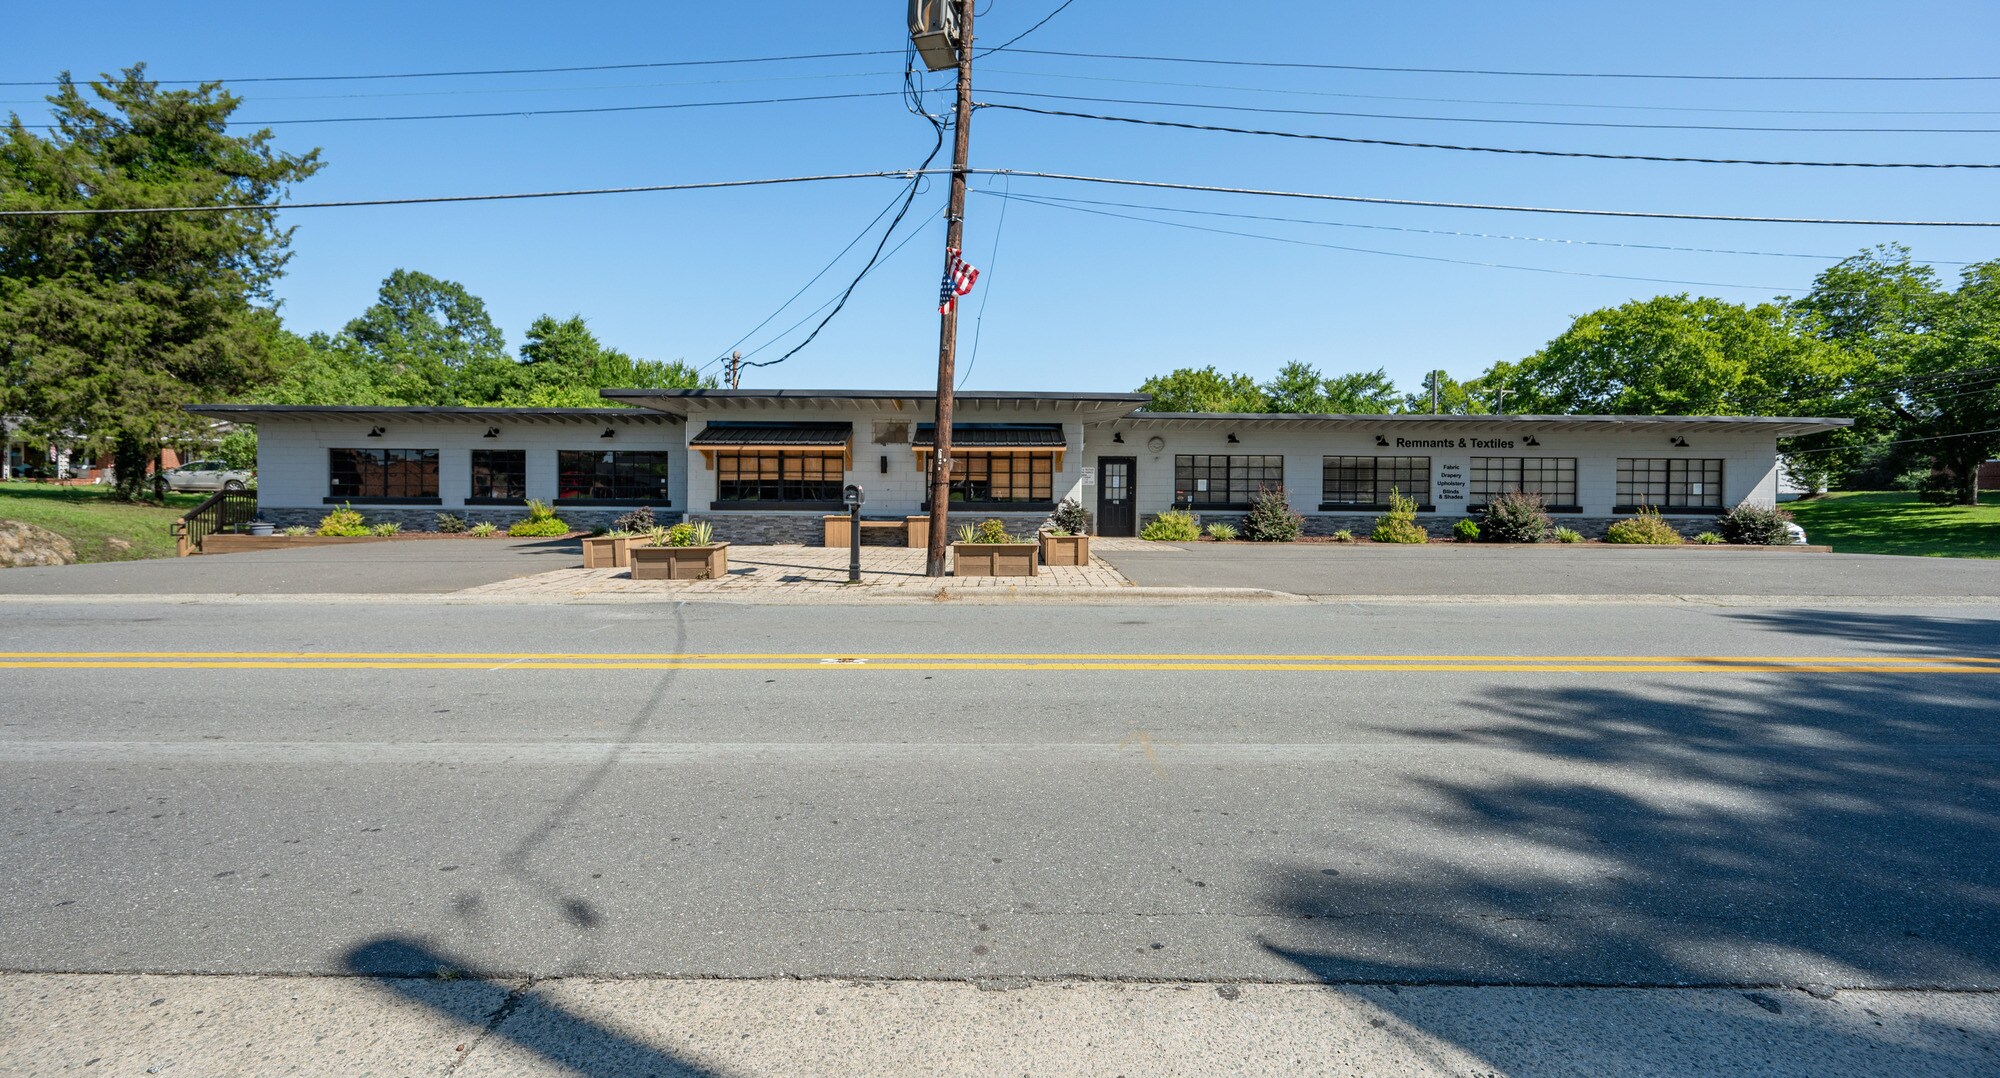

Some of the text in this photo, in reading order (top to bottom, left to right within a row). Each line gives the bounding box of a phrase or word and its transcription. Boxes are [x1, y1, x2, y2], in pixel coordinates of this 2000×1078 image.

[1396, 437, 1514, 448] Remnants & Textiles
